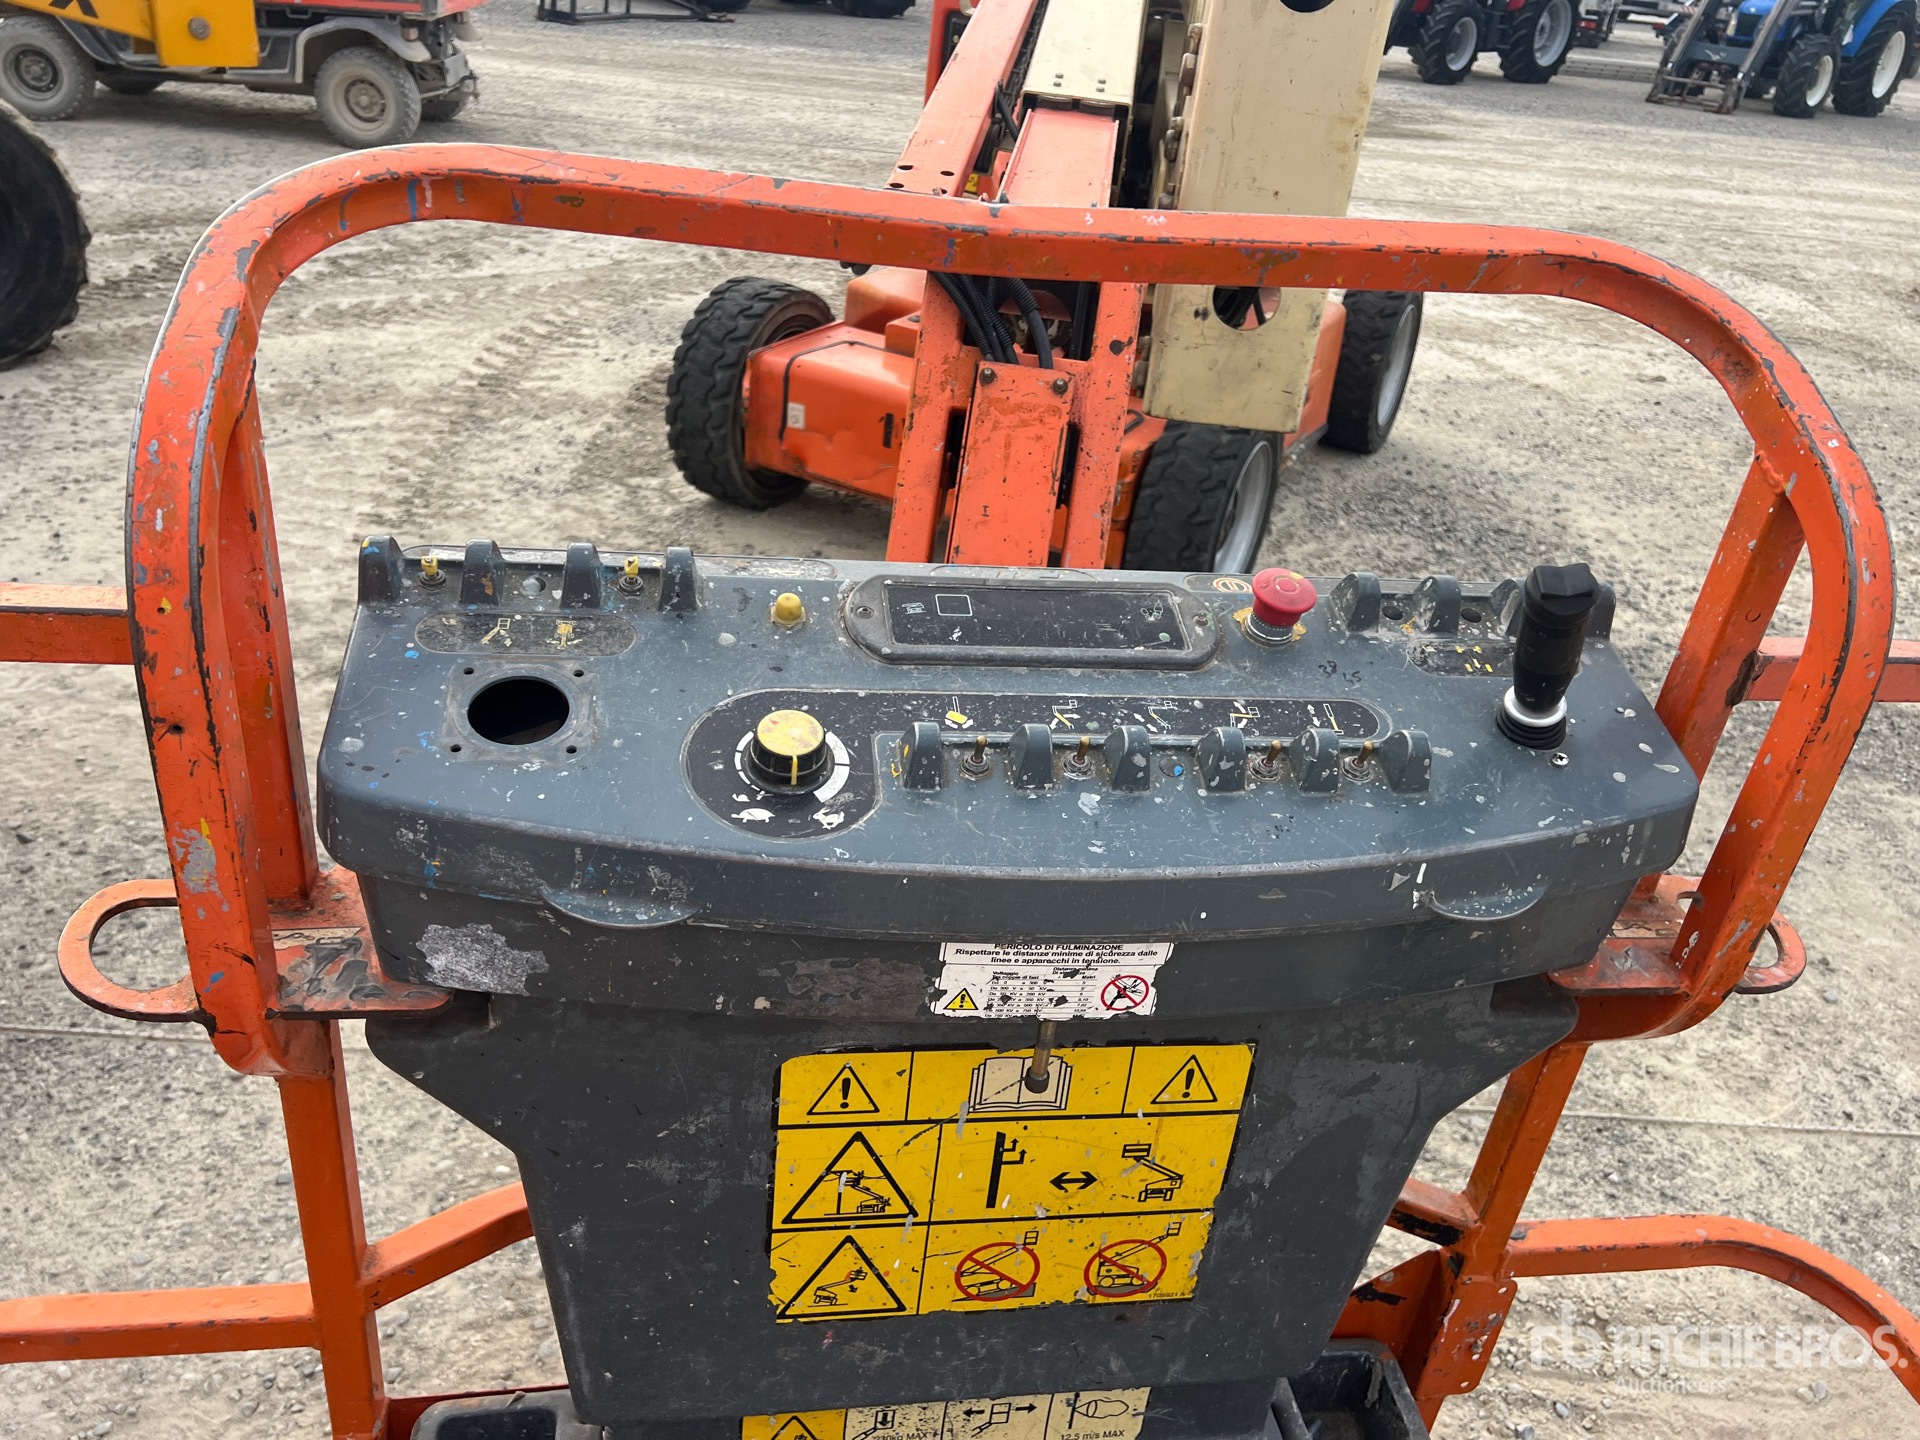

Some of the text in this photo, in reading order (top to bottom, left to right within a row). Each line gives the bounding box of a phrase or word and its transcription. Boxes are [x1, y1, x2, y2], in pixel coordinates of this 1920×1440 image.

[955, 948, 1001, 956] Rispettare
[906, 1432, 928, 1440] MAX
[1082, 1432, 1100, 1440] m/s
[1102, 1429, 1126, 1438] MAX
